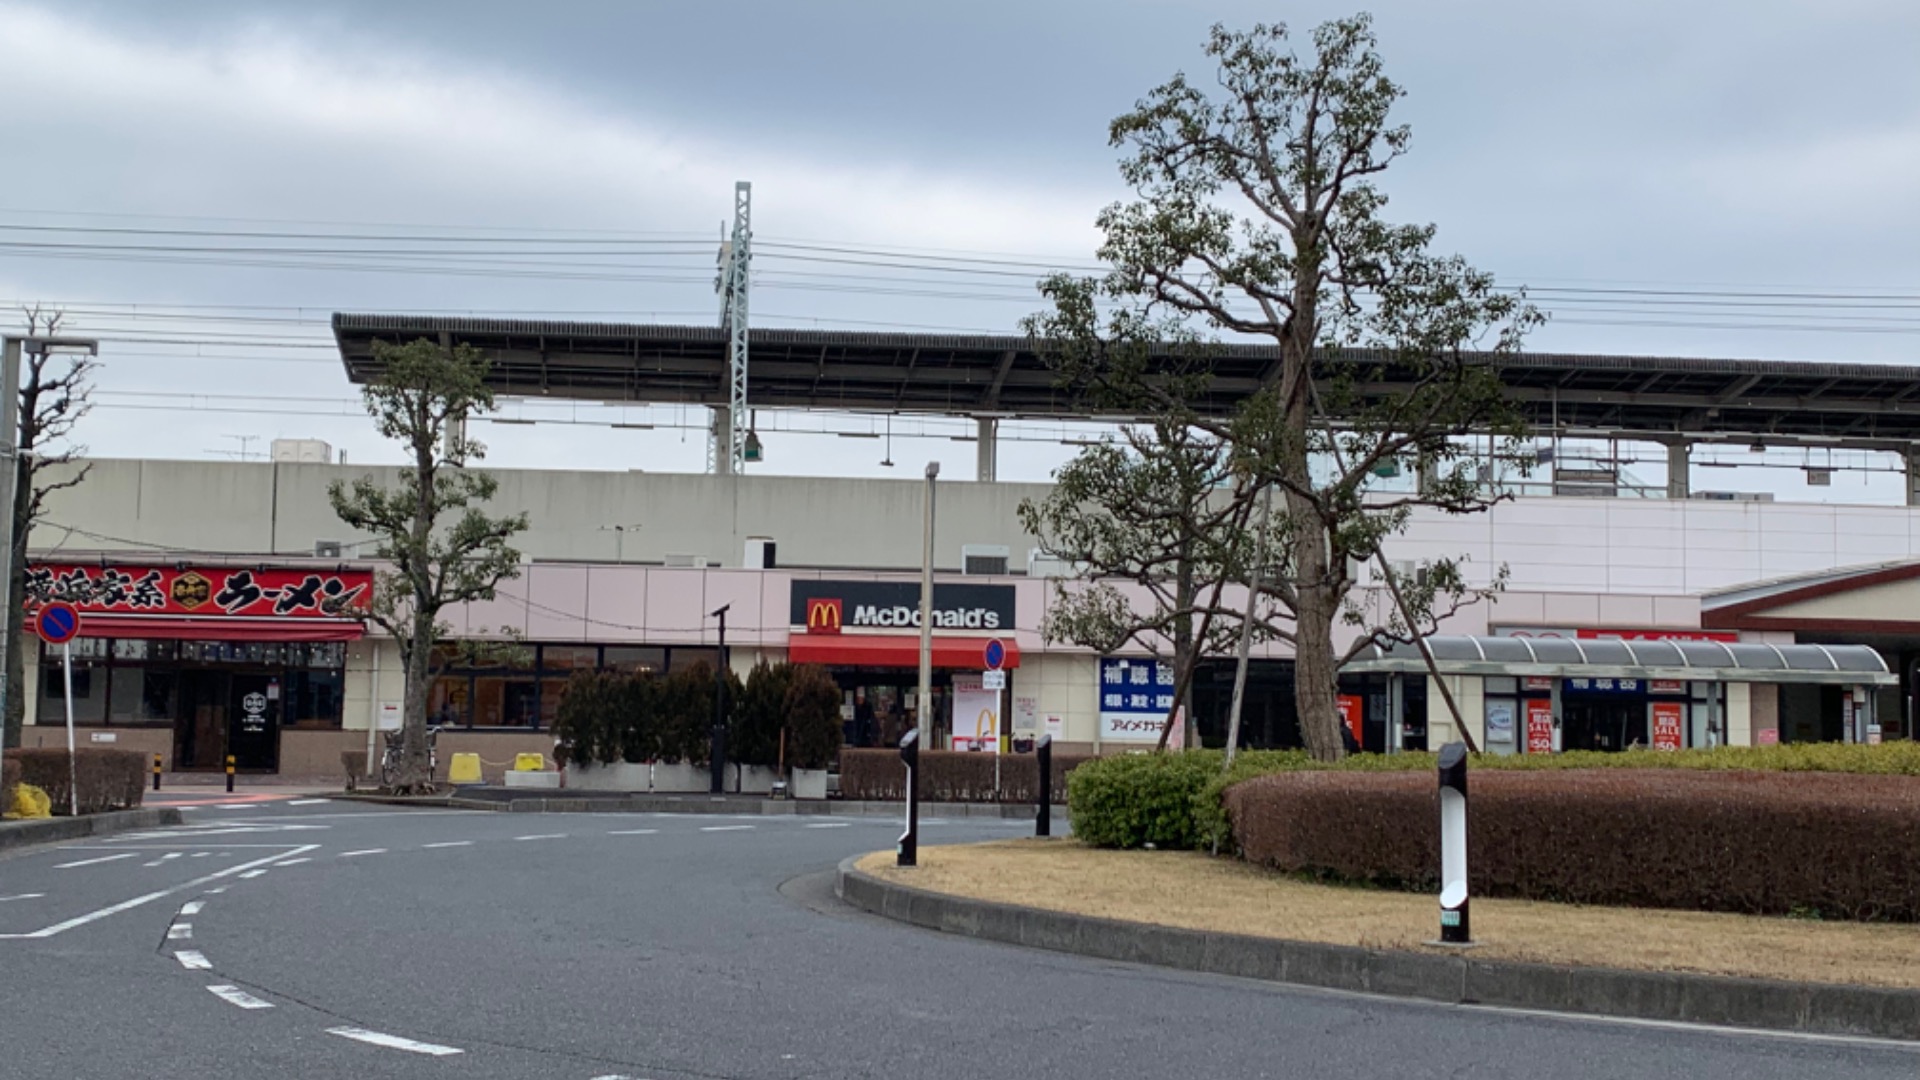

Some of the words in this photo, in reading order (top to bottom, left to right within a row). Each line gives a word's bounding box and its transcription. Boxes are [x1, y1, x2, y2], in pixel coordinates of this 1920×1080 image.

[213, 570, 368, 615] ラーメン
[853, 604, 1000, 629] McDonald's
